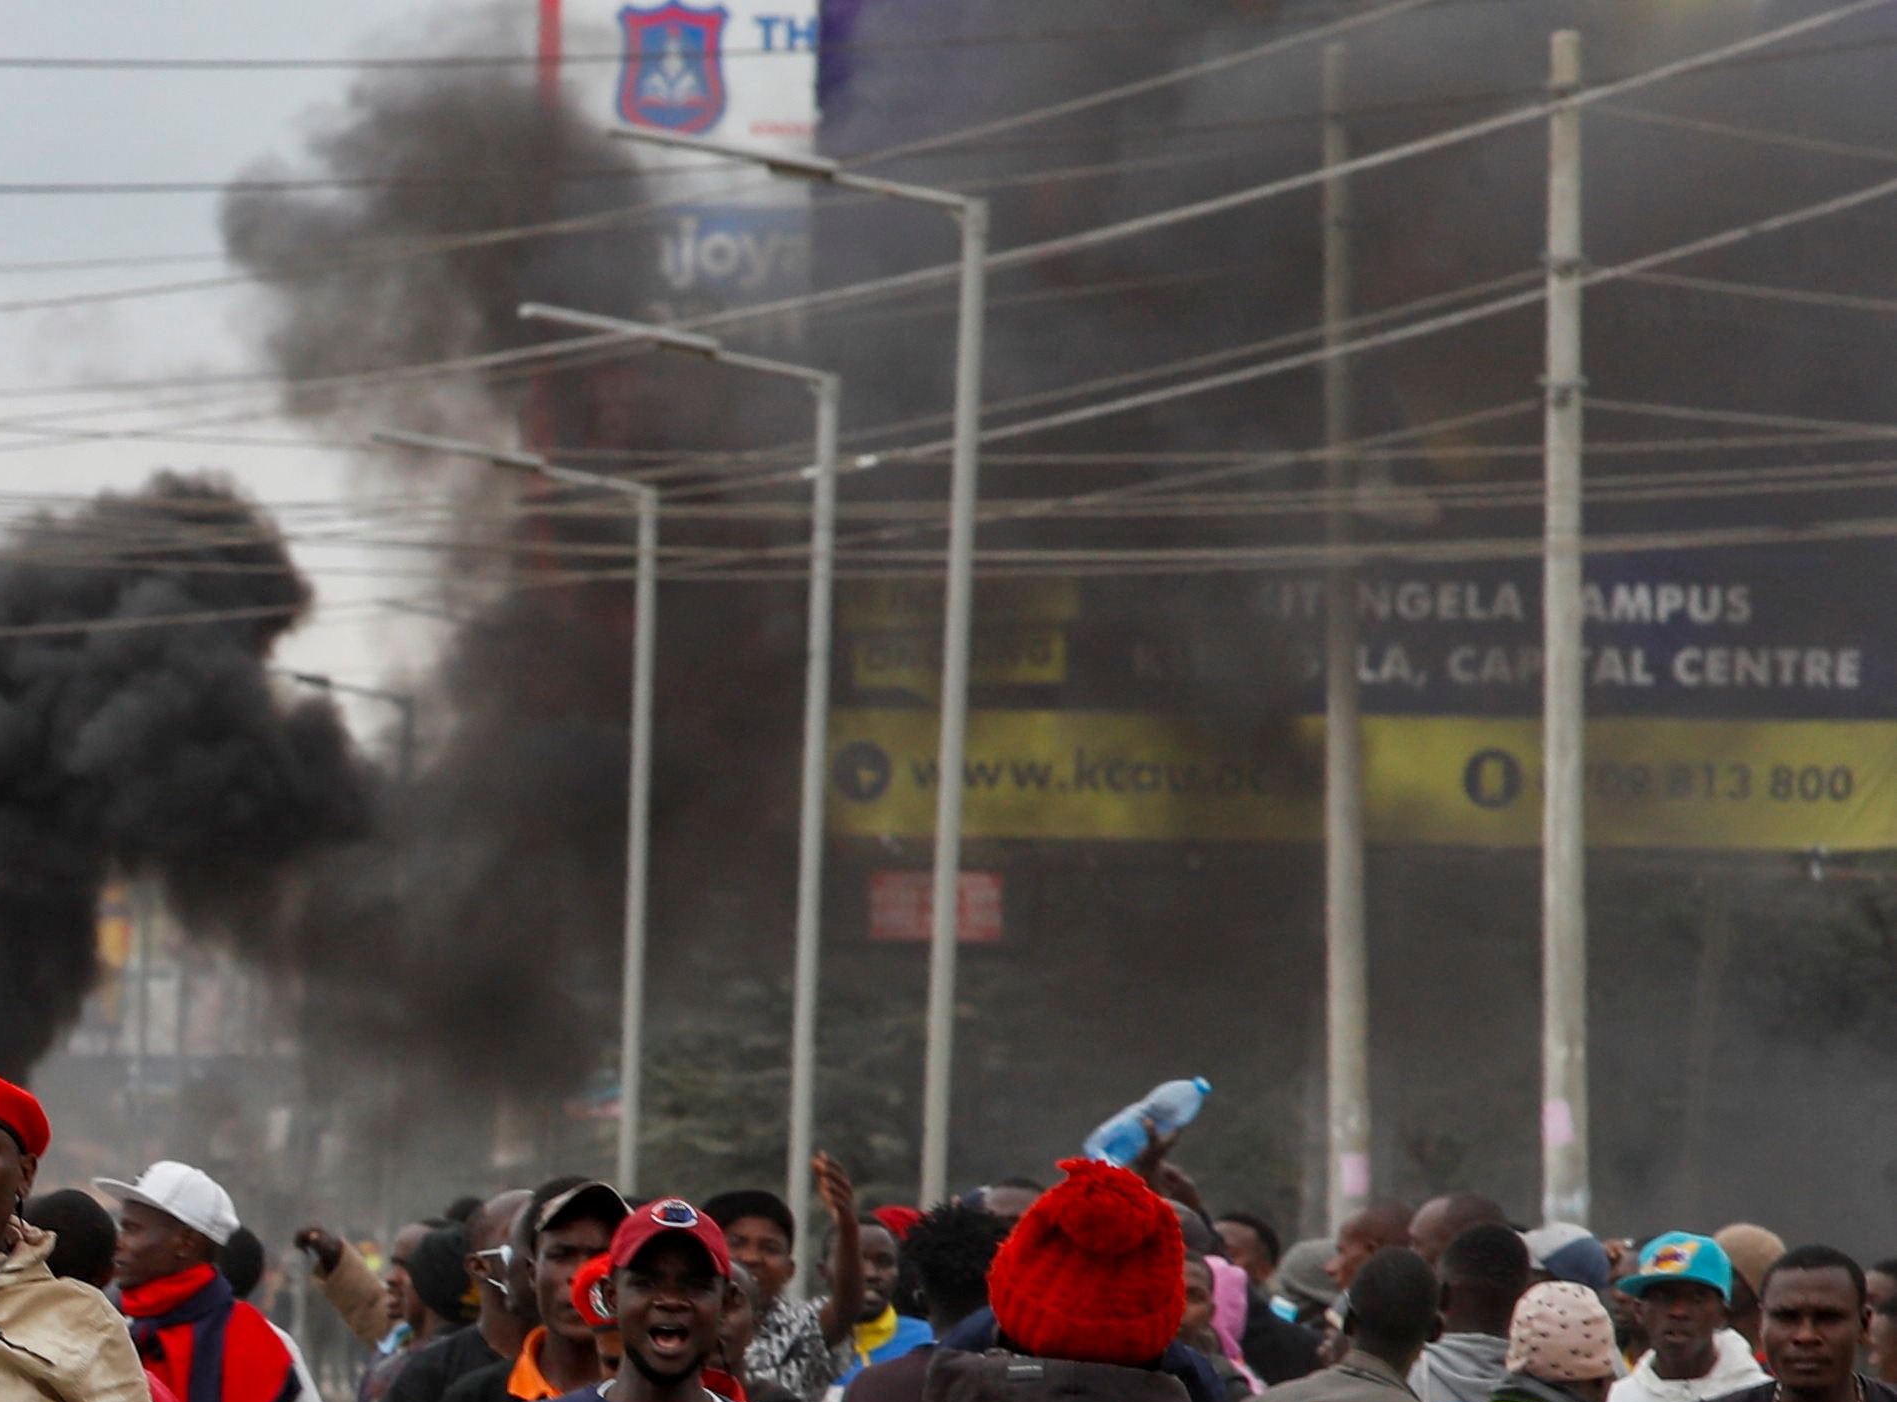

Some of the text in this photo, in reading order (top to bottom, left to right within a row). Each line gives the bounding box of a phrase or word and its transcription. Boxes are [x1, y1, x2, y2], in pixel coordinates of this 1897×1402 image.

[1548, 582, 1753, 624] AMPUS
[1448, 645, 1655, 686] CAPAL
[1672, 647, 1862, 689] CENTRE
[1768, 764, 1855, 802] 800
